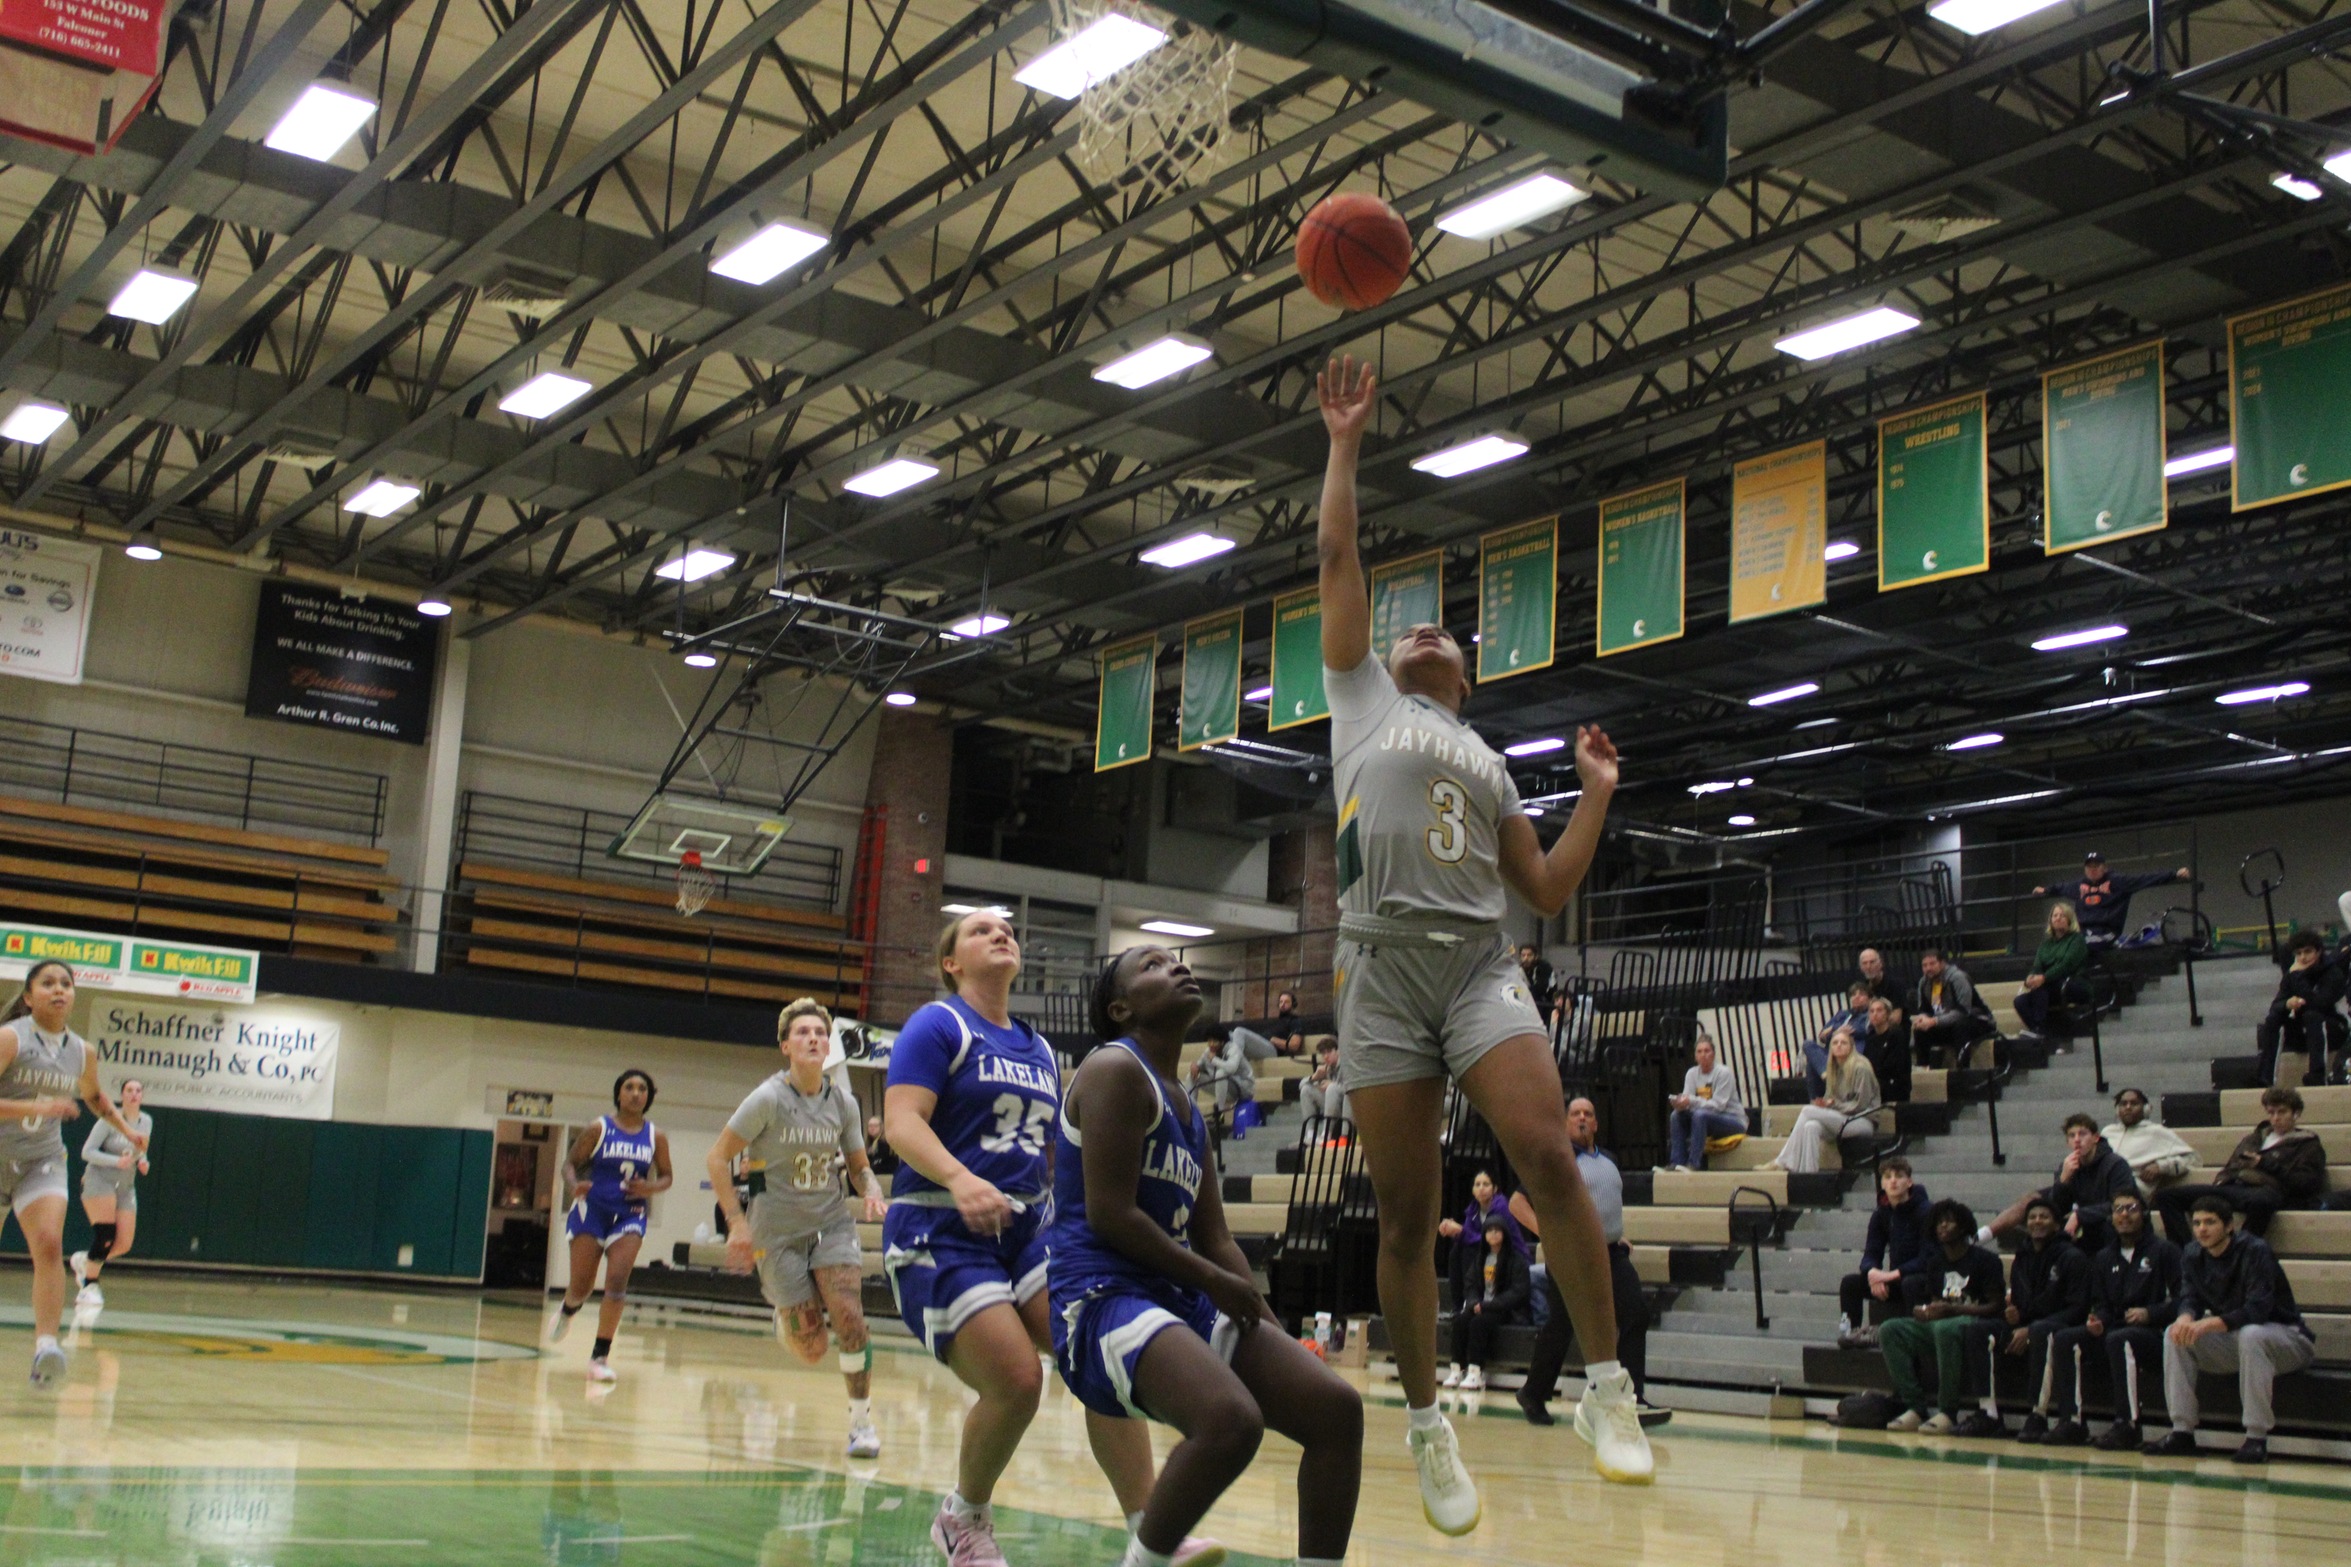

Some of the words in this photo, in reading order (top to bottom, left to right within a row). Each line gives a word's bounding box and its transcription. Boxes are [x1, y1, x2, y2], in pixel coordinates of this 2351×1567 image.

[56, 16, 108, 38] Falconer
[66, 4, 78, 15] W
[80, 6, 110, 24] Main
[113, 18, 126, 30] St
[1904, 422, 1960, 449] WRESTLING
[282, 594, 321, 610] Thanks
[324, 600, 340, 613] for
[343, 604, 380, 624] Talking
[383, 612, 394, 624] To
[397, 616, 421, 630] Your
[294, 610, 318, 624] Kids
[321, 615, 354, 630] About
[276, 636, 293, 648] WE
[296, 640, 313, 654] ALL
[316, 644, 345, 658] MAKE
[346, 648, 354, 660] A
[277, 704, 318, 719] Arthur
[332, 712, 360, 726] Gren
[1426, 778, 1469, 864] 3
[30, 936, 82, 961] Kwik
[163, 952, 212, 976] Kwik
[108, 1008, 225, 1043] Schaffner
[236, 1022, 318, 1057] Knight
[96, 1039, 222, 1079] Minnaugh
[228, 1056, 249, 1075] &
[256, 1054, 296, 1085] Co,
[300, 1066, 325, 1084] PC
[980, 1092, 1056, 1157] 35
